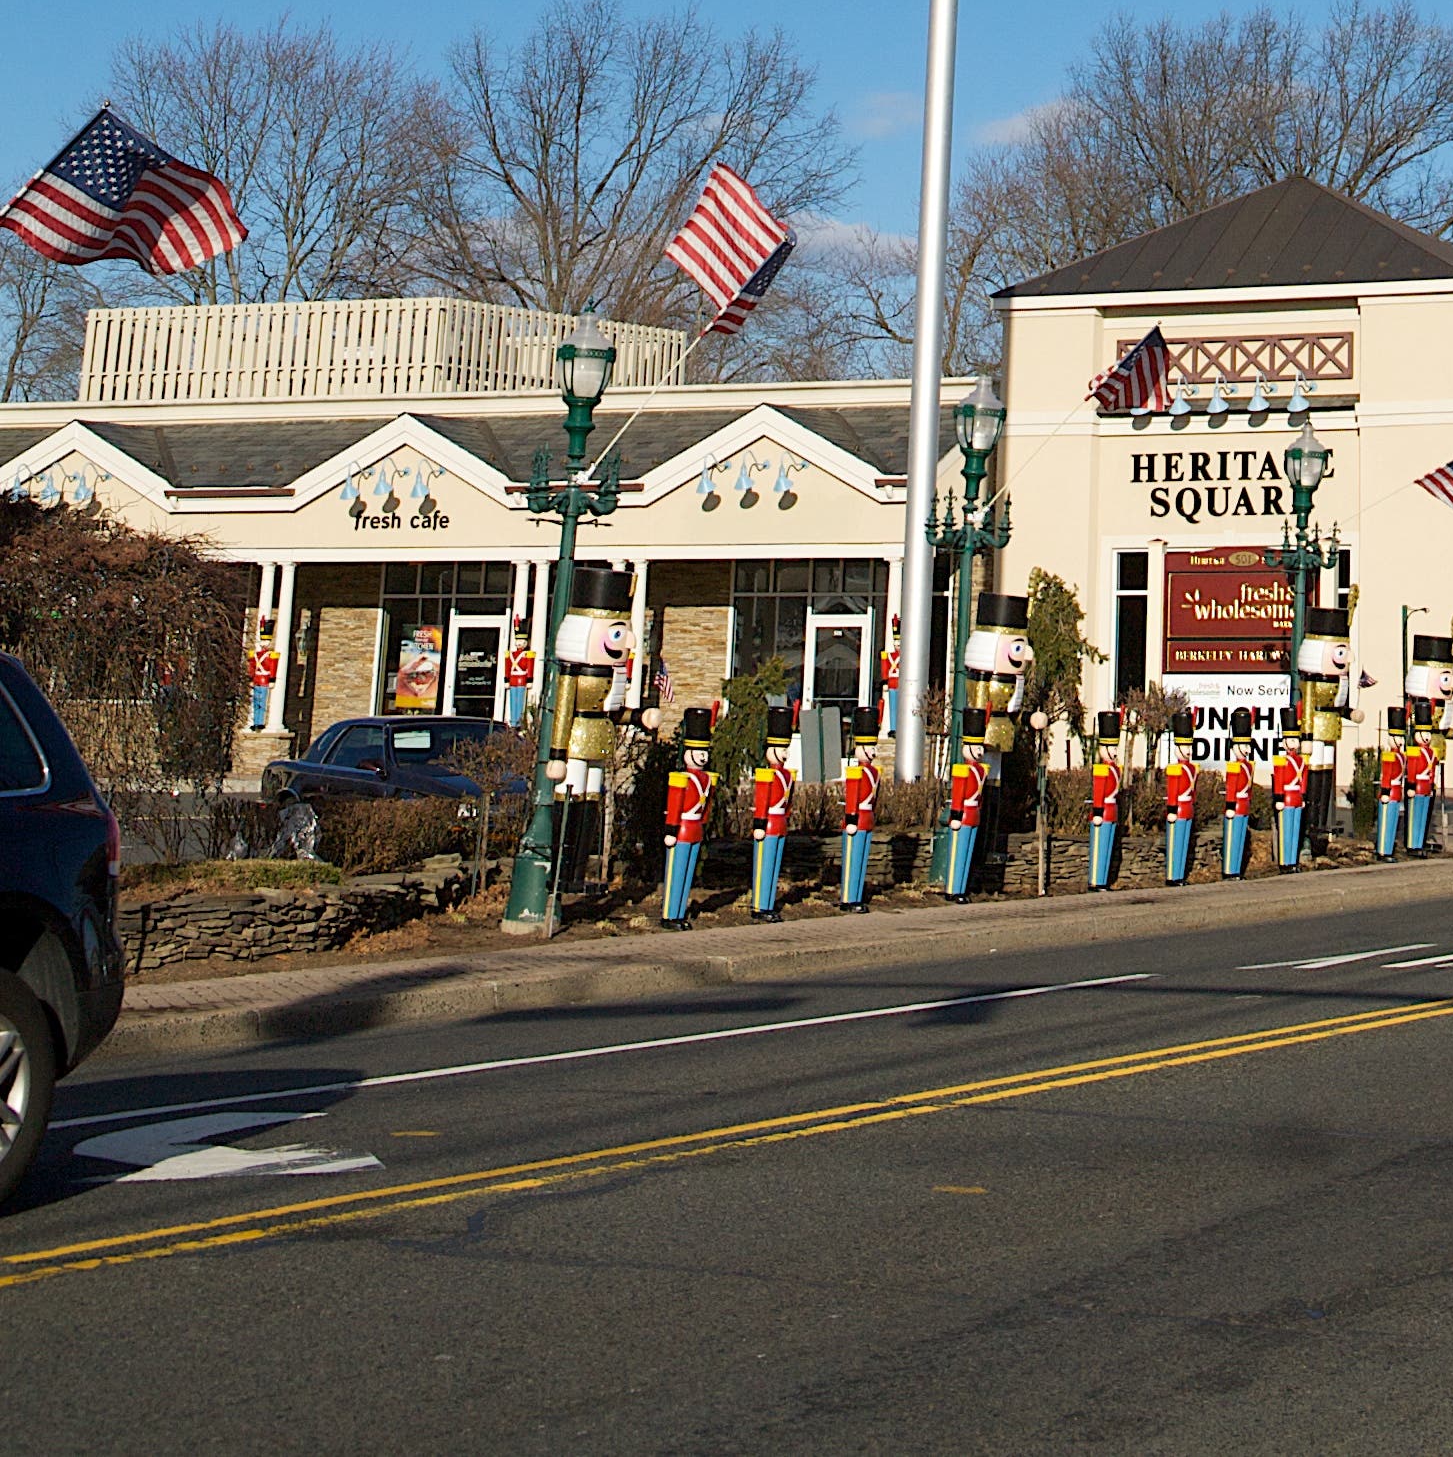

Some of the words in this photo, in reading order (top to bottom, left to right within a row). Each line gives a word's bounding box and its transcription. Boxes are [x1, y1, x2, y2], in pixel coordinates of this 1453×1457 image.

[1130, 448, 1335, 484] HERITAE
[1150, 485, 1298, 525] SQUAR
[354, 509, 401, 532] fresh
[410, 509, 450, 532] cafe
[1235, 554, 1253, 564] 501
[1239, 649, 1291, 662] HARDWA
[1227, 685, 1255, 696] Now
[1258, 684, 1289, 696] Servi
